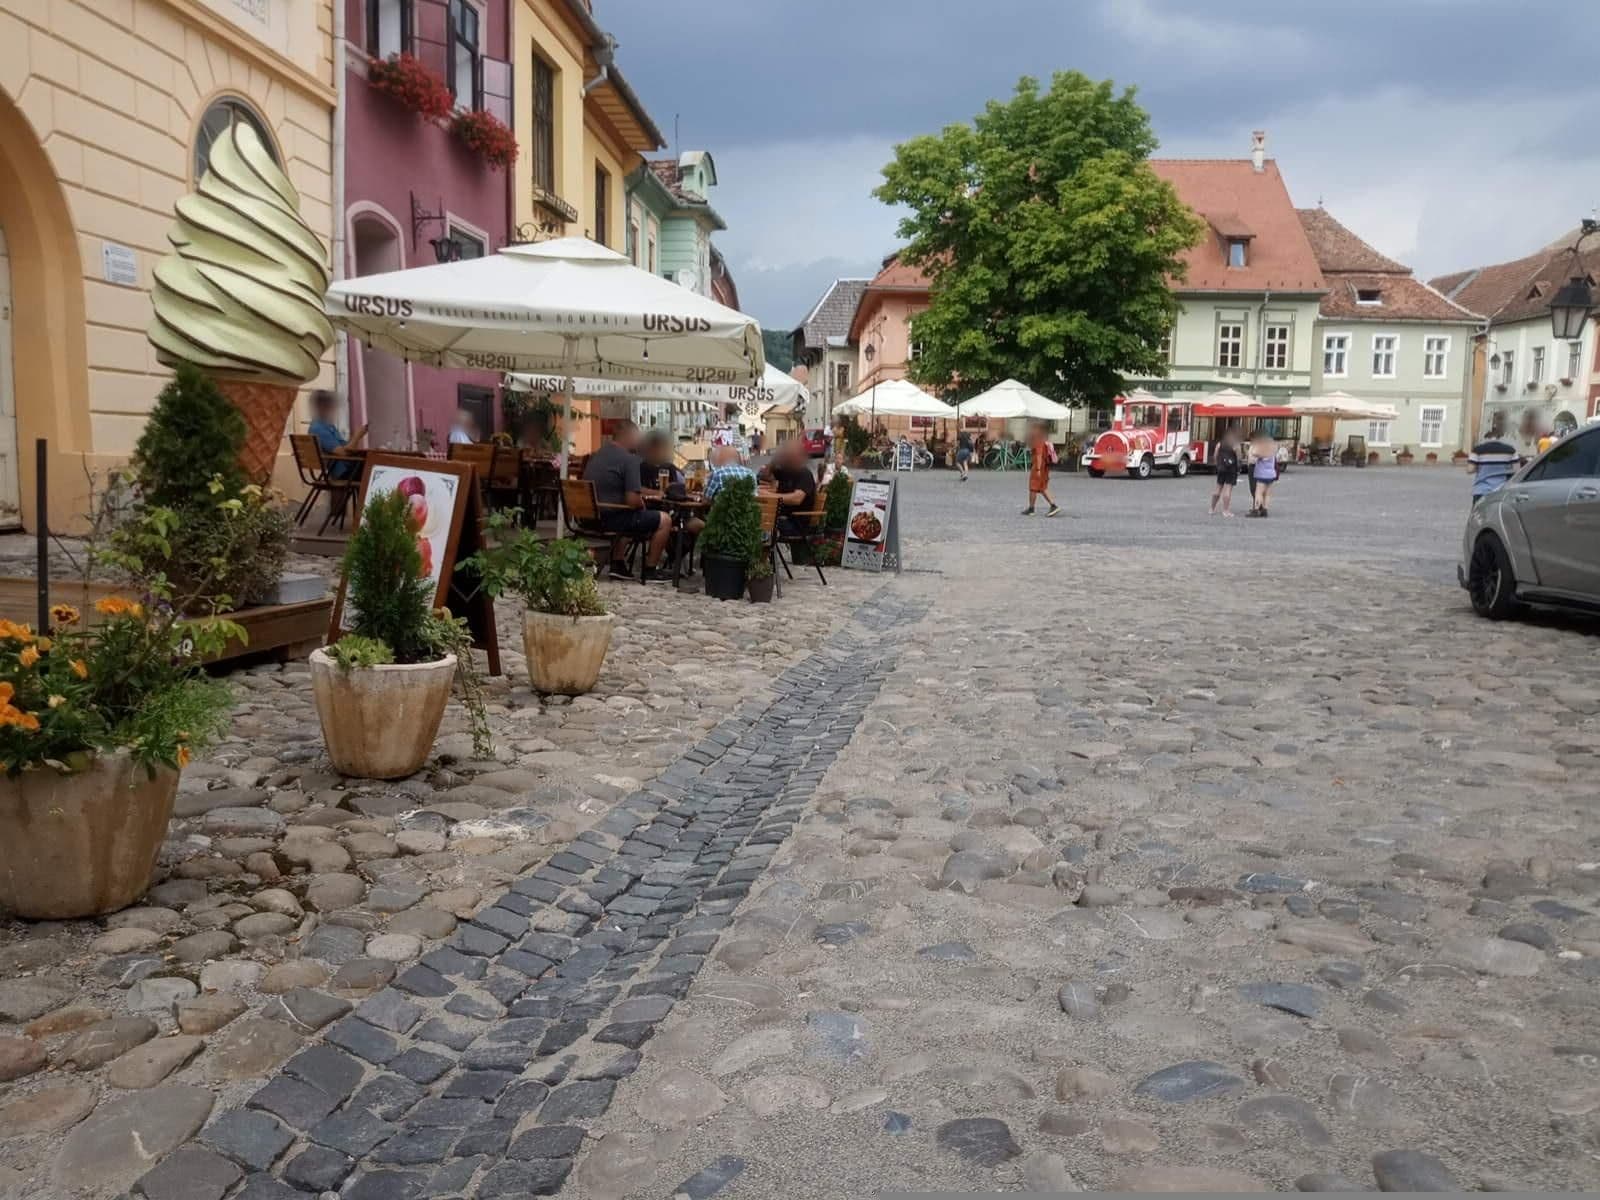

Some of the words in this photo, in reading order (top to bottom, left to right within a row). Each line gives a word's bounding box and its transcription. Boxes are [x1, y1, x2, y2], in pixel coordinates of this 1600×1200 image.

[344, 294, 413, 317] URSUS
[643, 313, 711, 333] URSUS
[728, 386, 774, 401] URSUS
